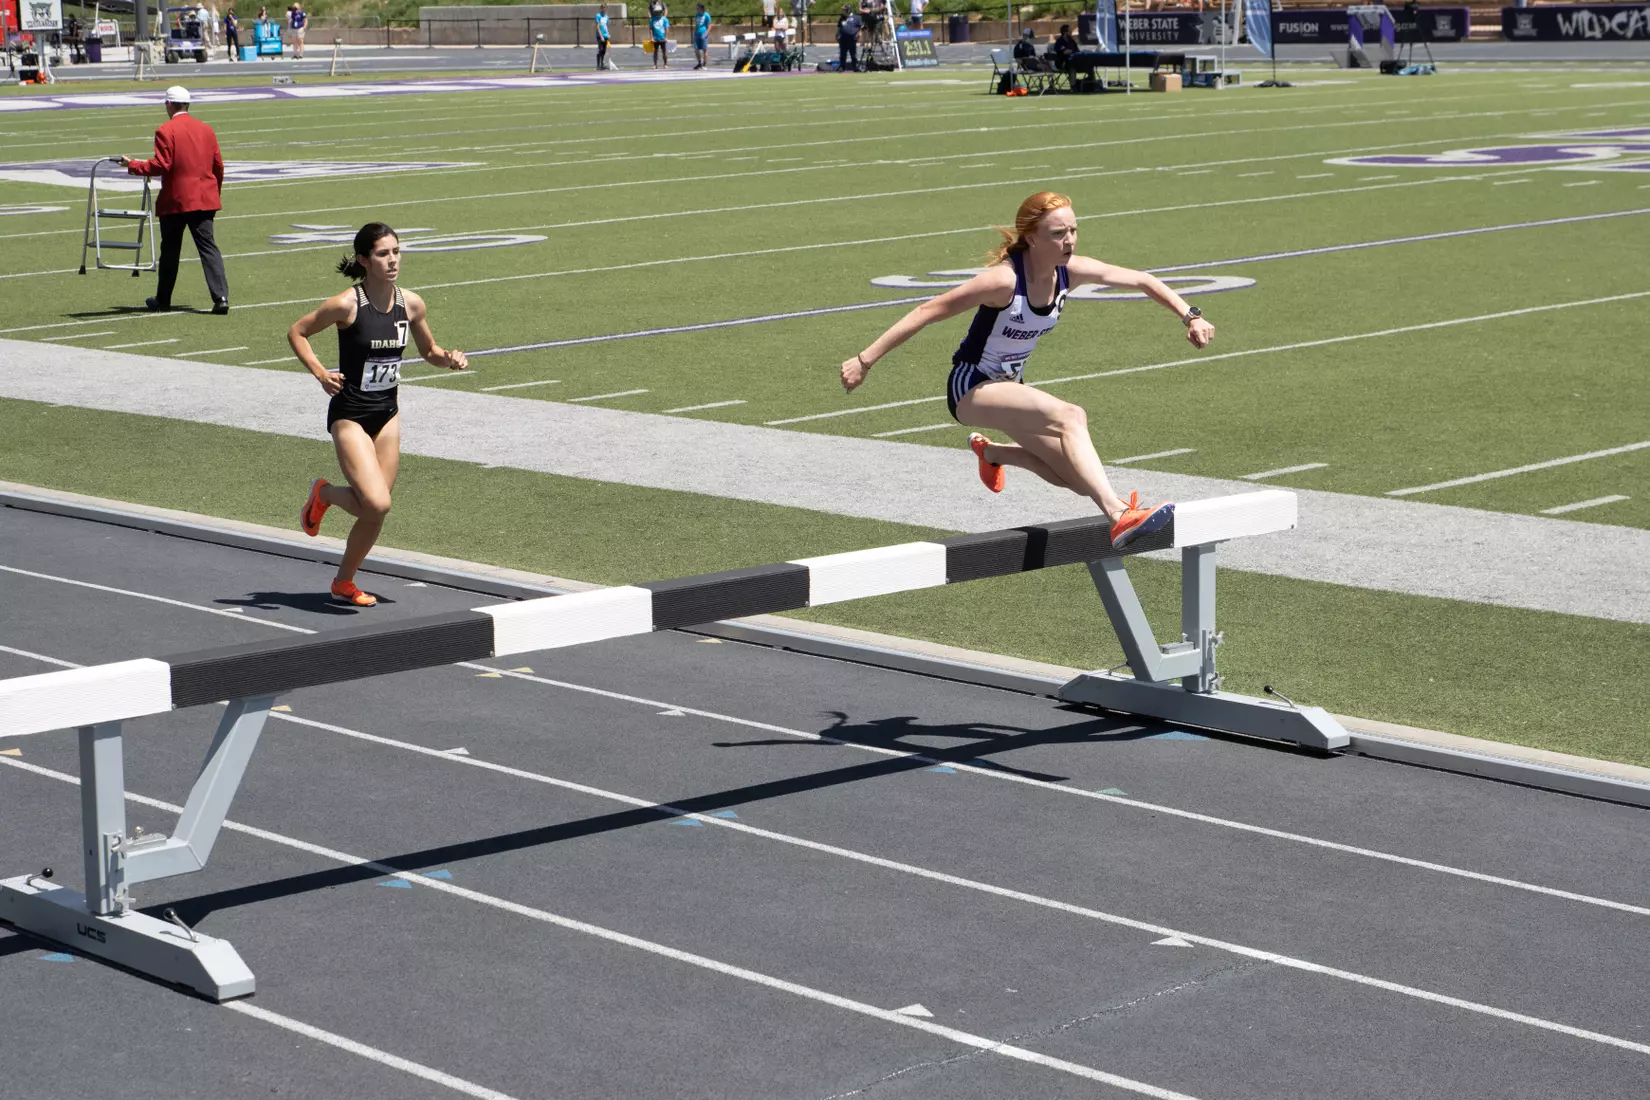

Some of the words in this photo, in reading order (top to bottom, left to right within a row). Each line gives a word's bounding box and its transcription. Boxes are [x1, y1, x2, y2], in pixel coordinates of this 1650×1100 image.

[1118, 18, 1150, 30] WEBER
[1151, 17, 1179, 29] STATE
[1121, 31, 1179, 41] UNIVERSITY
[1001, 325, 1039, 340] WEBER
[369, 364, 397, 383] 173
[77, 922, 106, 944] UCS
